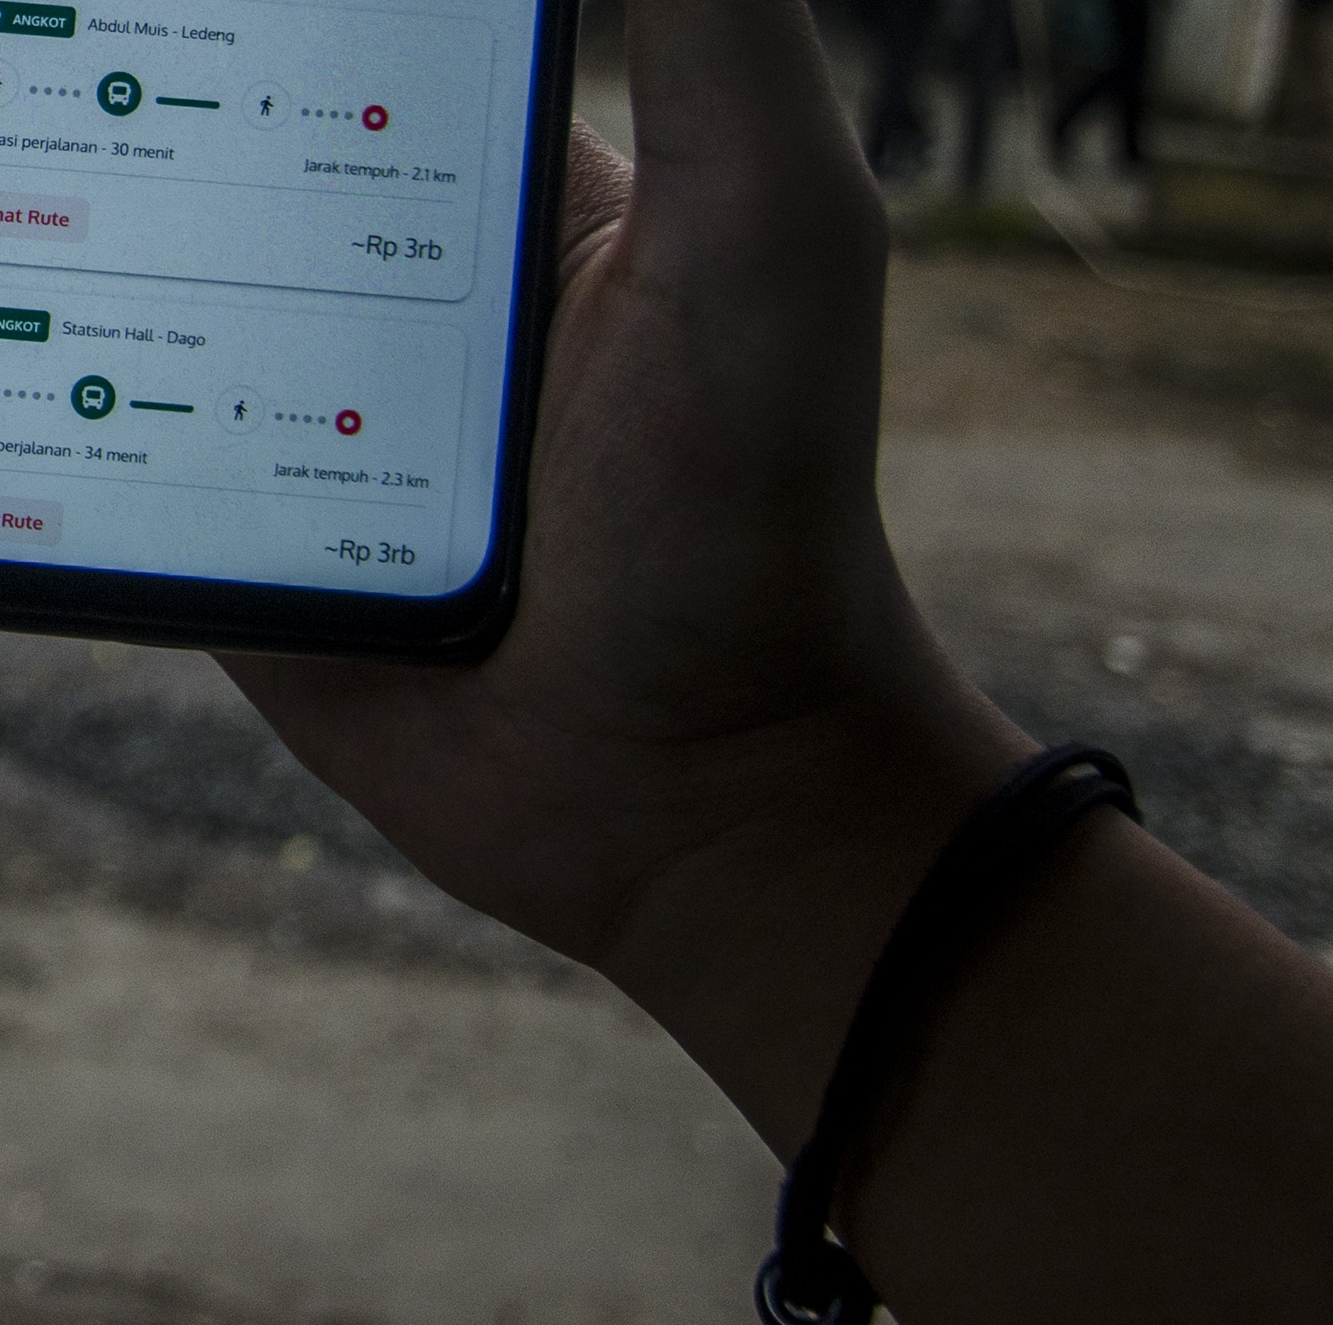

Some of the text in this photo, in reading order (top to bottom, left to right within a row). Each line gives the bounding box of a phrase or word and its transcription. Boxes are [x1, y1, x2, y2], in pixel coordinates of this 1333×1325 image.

[13, 14, 66, 29] ANGKOT
[88, 18, 130, 34] Abdul
[135, 21, 168, 37] Muis
[182, 25, 235, 46] Ledeng
[22, 134, 97, 156] perjalanan
[111, 142, 129, 156] 30
[133, 142, 175, 160] menit
[304, 159, 340, 176] Jarak
[344, 162, 399, 182] tempuh
[413, 167, 431, 181] 2.1
[434, 168, 456, 183] km
[28, 209, 70, 227] Rute
[405, 236, 443, 261] 3rb
[62, 321, 121, 340] Statsiun
[125, 326, 153, 342] Hall
[167, 328, 206, 348] Dago
[85, 445, 102, 460] 34
[107, 446, 148, 464] menit
[275, 462, 310, 479] Jarak
[314, 466, 369, 486] tempuh
[382, 472, 403, 486] 2.3
[407, 473, 429, 488] km
[2, 512, 44, 531] Rute
[378, 541, 416, 566] 3rb
